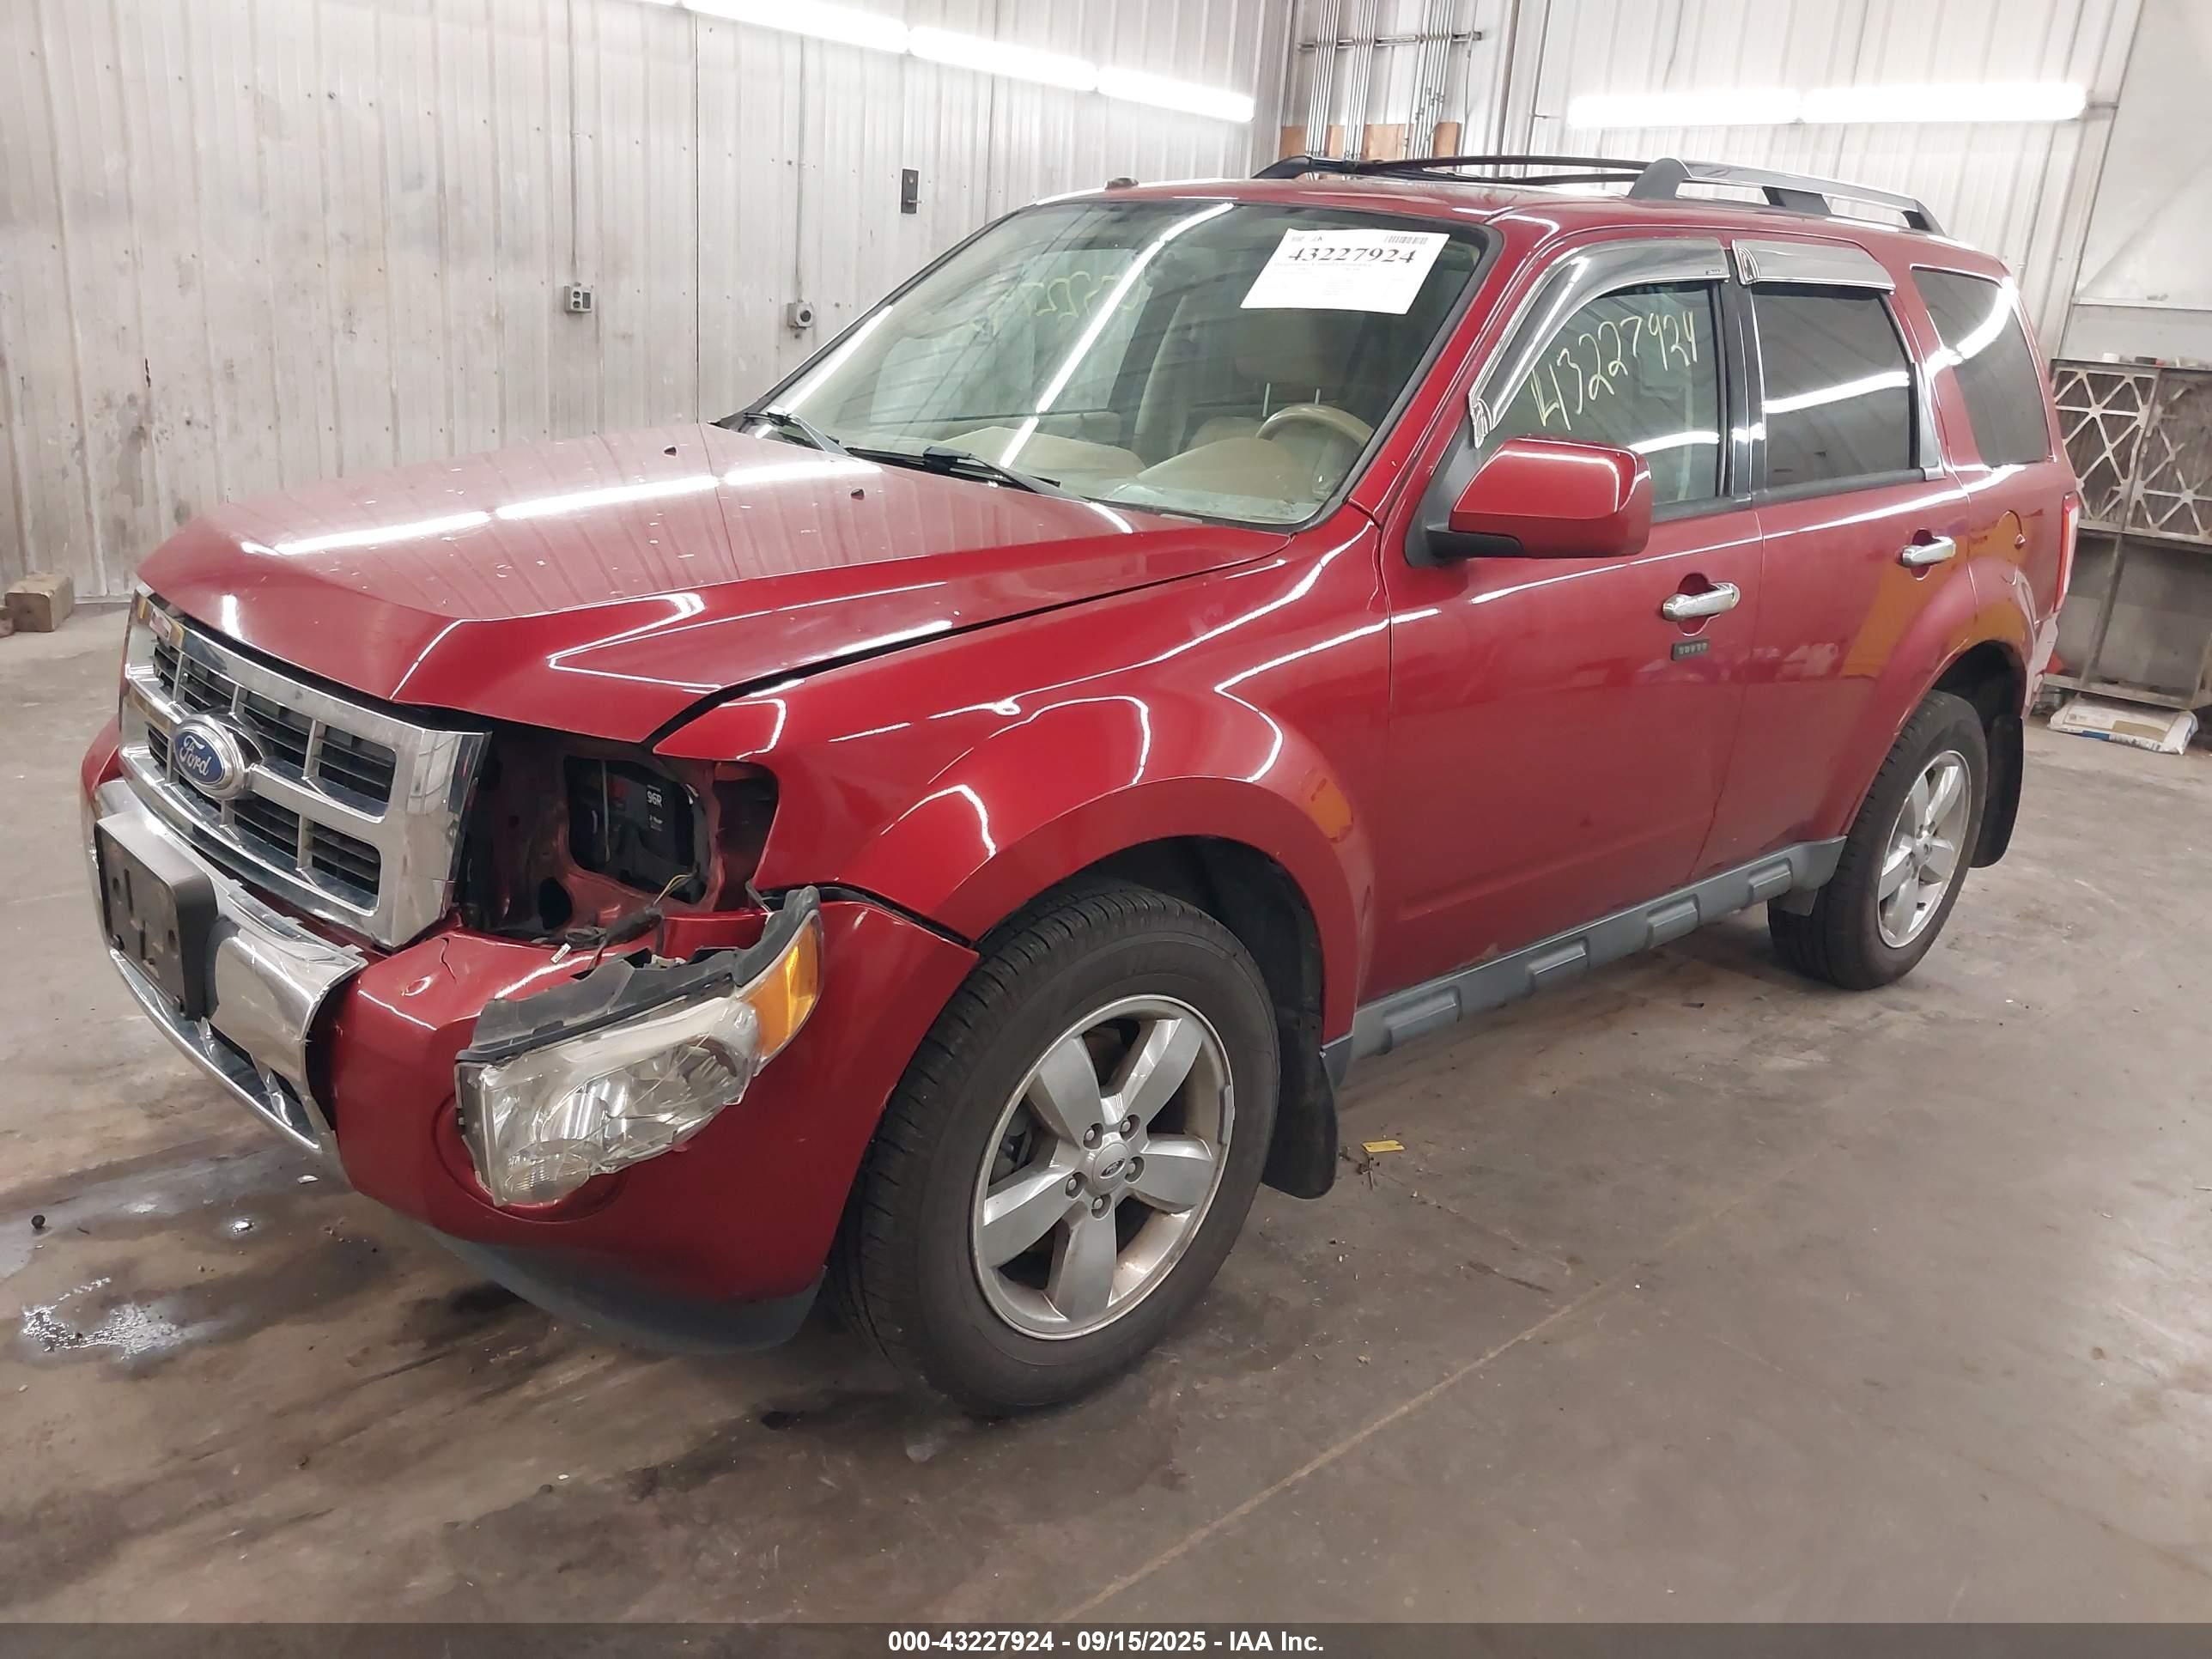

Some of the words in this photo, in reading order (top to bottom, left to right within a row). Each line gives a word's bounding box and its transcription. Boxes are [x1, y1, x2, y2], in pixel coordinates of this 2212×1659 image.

[1289, 247, 1417, 264] 43227924
[1529, 310, 1698, 431] 43227924
[179, 735, 212, 775] Ford
[647, 790, 663, 808] 96R
